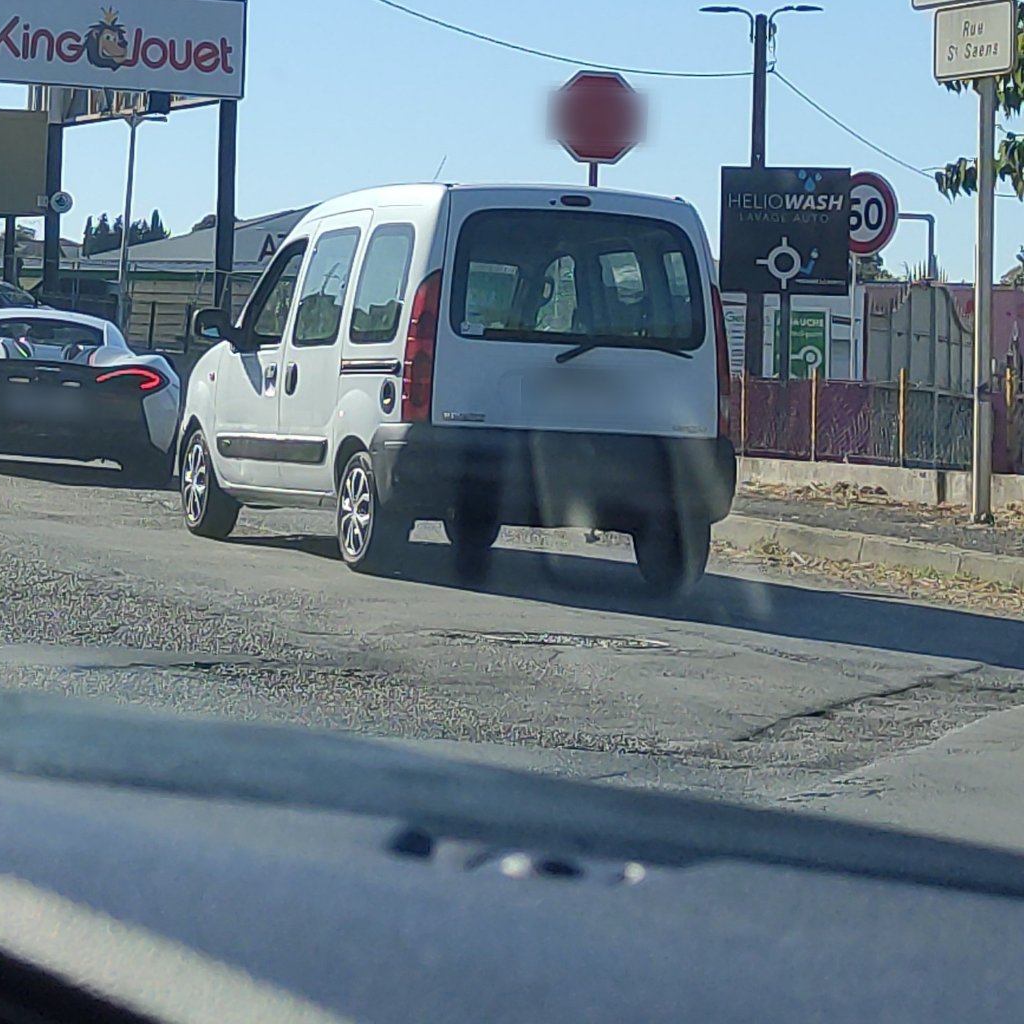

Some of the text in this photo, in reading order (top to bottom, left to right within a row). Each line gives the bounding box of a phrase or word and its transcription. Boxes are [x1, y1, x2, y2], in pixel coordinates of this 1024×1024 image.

[962, 20, 984, 37] Rue
[123, 27, 234, 74] Jouet
[964, 42, 998, 59] Saens
[728, 193, 844, 210] HELIOWASH
[739, 212, 830, 224] LAVAGE AUTO
[849, 197, 883, 231] 50
